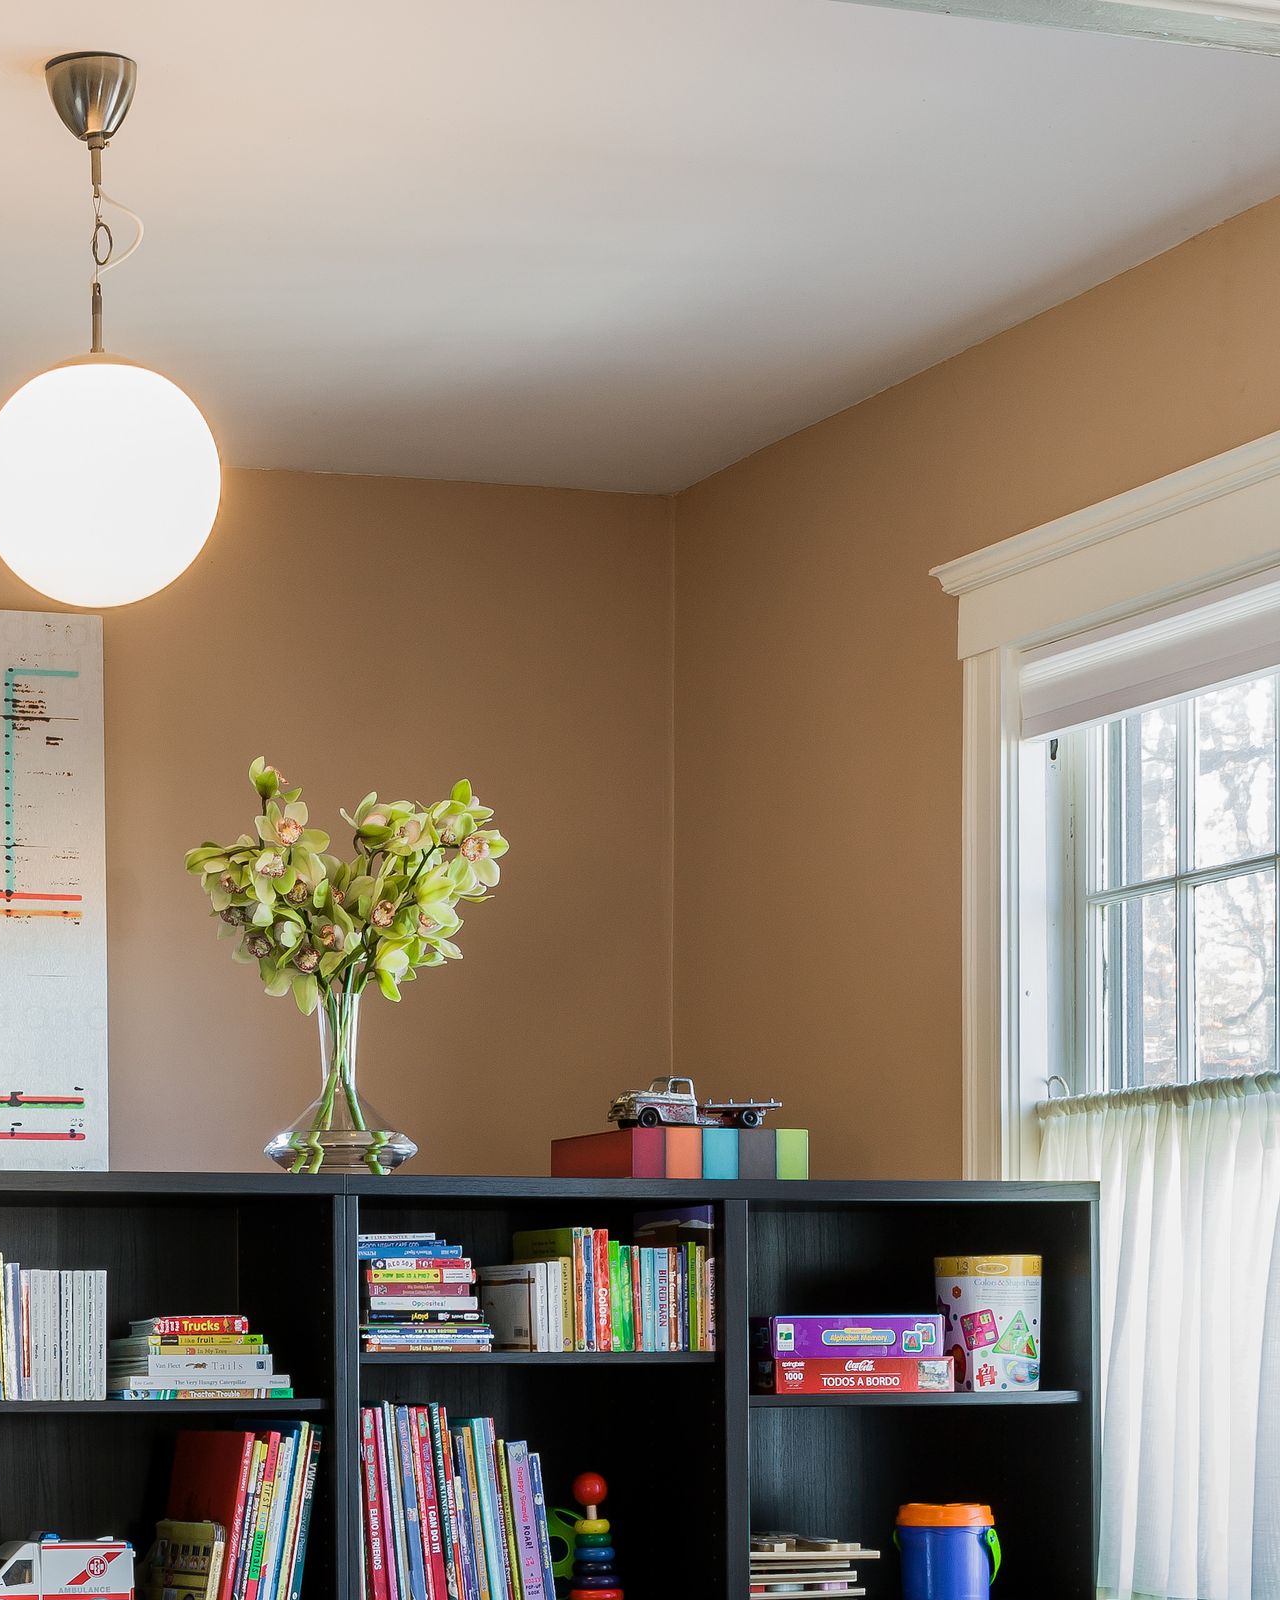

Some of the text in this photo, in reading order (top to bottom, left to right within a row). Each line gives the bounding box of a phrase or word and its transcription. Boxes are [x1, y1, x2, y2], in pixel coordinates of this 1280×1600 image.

[659, 1269, 667, 1327] BIG RED BARN
[598, 1287, 608, 1326] Colors
[182, 1320, 220, 1332] Trucks
[197, 1336, 214, 1344] fruit
[211, 1361, 244, 1370] Tails
[784, 1372, 804, 1381] 1000
[822, 1376, 900, 1387] TODOS A BORDO
[515, 1466, 526, 1494] Snappy
[523, 1525, 534, 1550] ROAR!
[370, 1508, 378, 1530] ELMO
[429, 1510, 437, 1526] CAN
[430, 1527, 438, 1537] DO
[372, 1536, 382, 1570] FRIENDS
[58, 1586, 111, 1594] AMBULANCE
